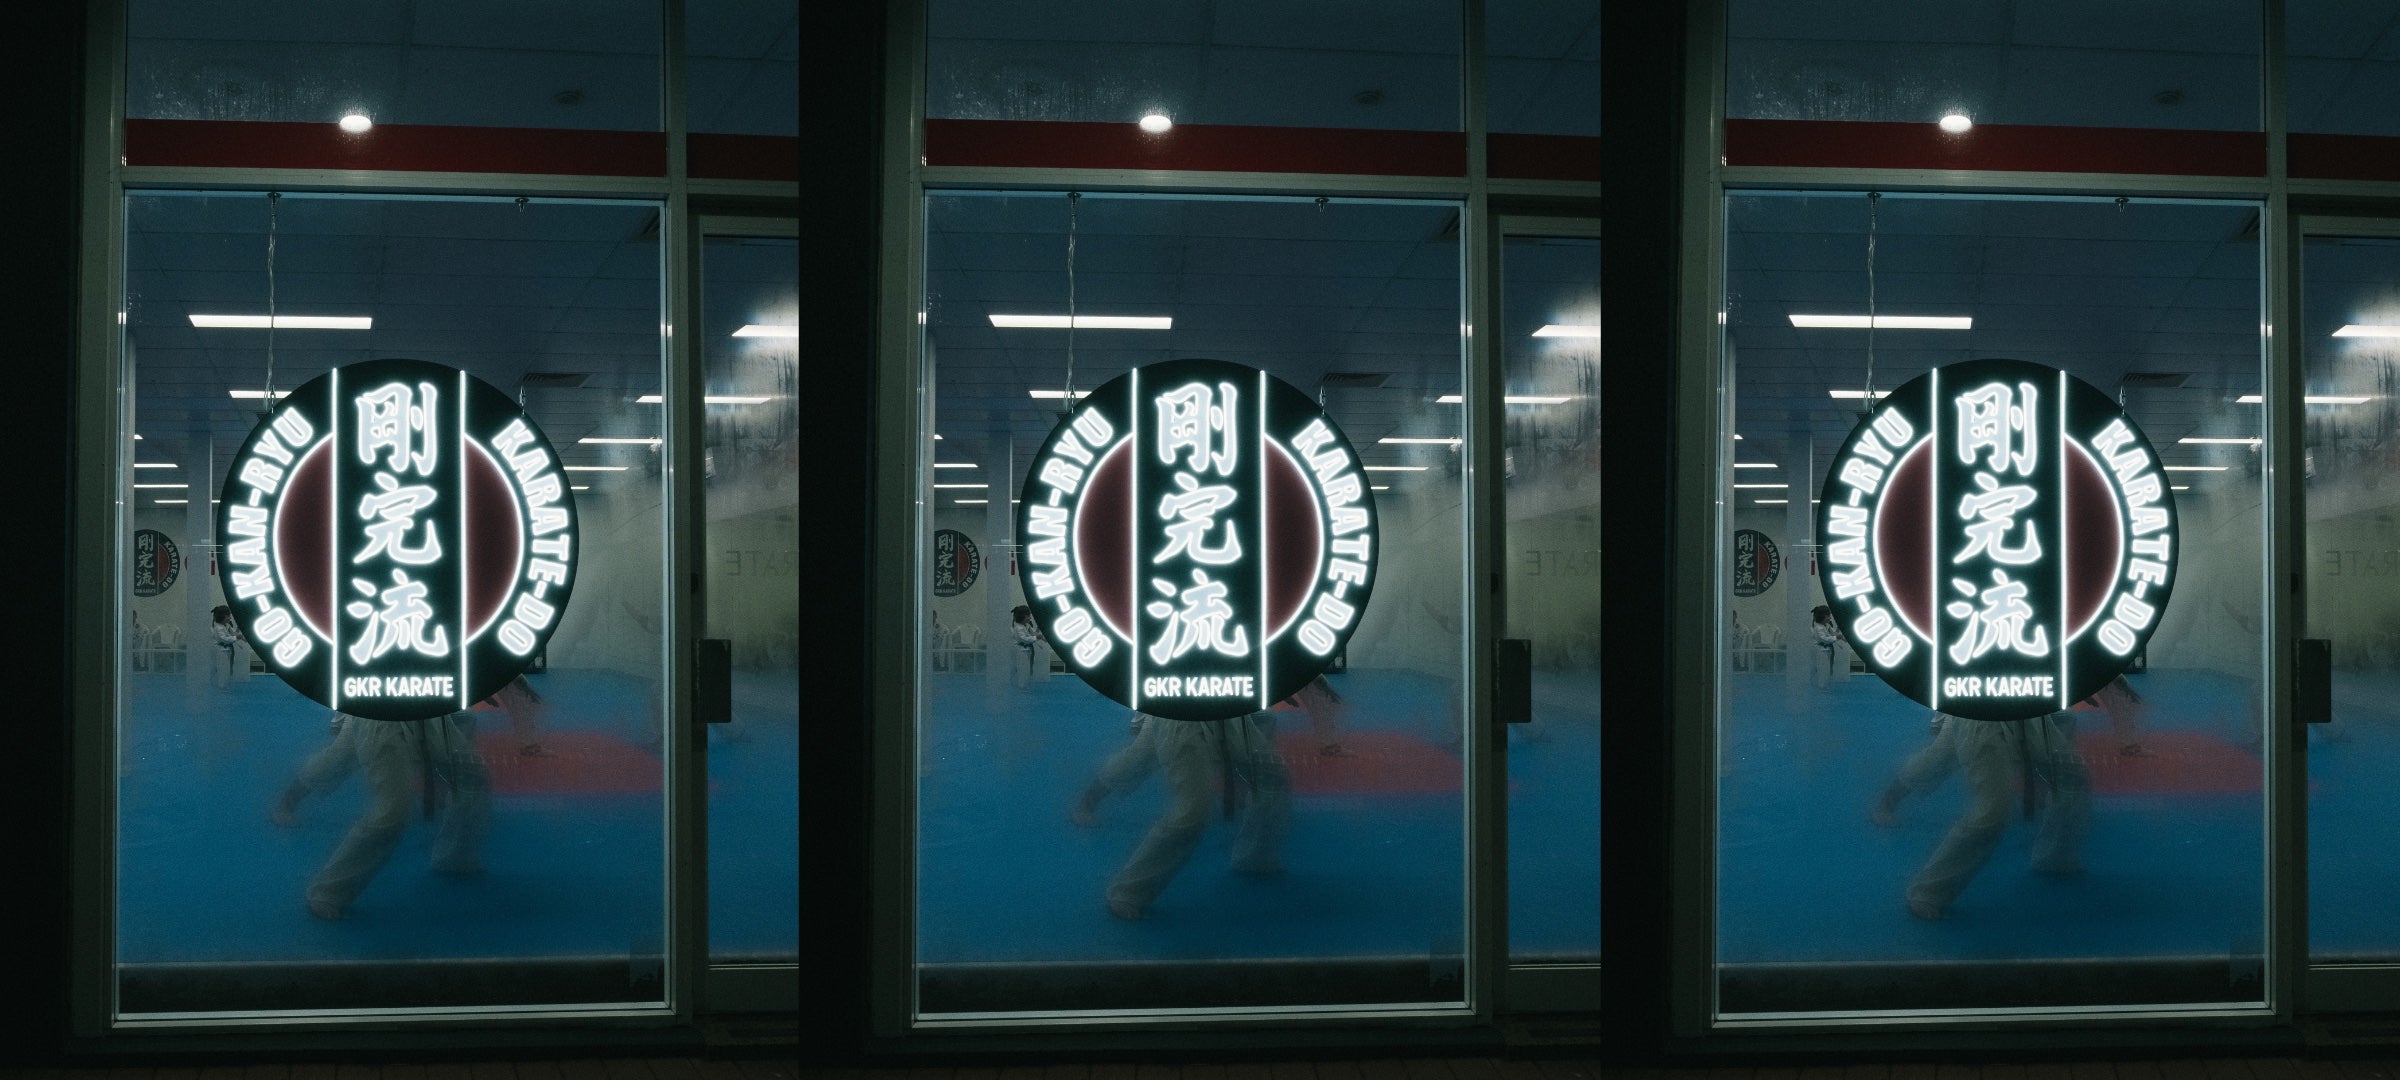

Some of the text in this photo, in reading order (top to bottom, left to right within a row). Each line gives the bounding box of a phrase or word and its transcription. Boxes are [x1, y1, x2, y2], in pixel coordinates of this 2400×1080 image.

[162, 541, 178, 588] KARATE-DO
[228, 407, 314, 668] GO-KAN-RYU
[345, 382, 450, 666] 剛完流
[491, 418, 570, 656] KARATE-DO
[962, 541, 978, 588] KARATE-DO
[1028, 407, 1114, 668] GO-KAN-RYU
[1145, 382, 1250, 666] 剛完流
[1291, 418, 1370, 656] KARATE-DO
[1762, 541, 1778, 588] KARATE-DO
[1828, 407, 1914, 668] GO-KAN-RYU
[1945, 382, 2050, 666] 剛完流
[2091, 418, 2170, 656] KARATE-DO
[344, 676, 454, 698] GKR KARATE
[1144, 676, 1254, 698] GKR KARATE
[1944, 676, 2054, 698] GKR KARATE
